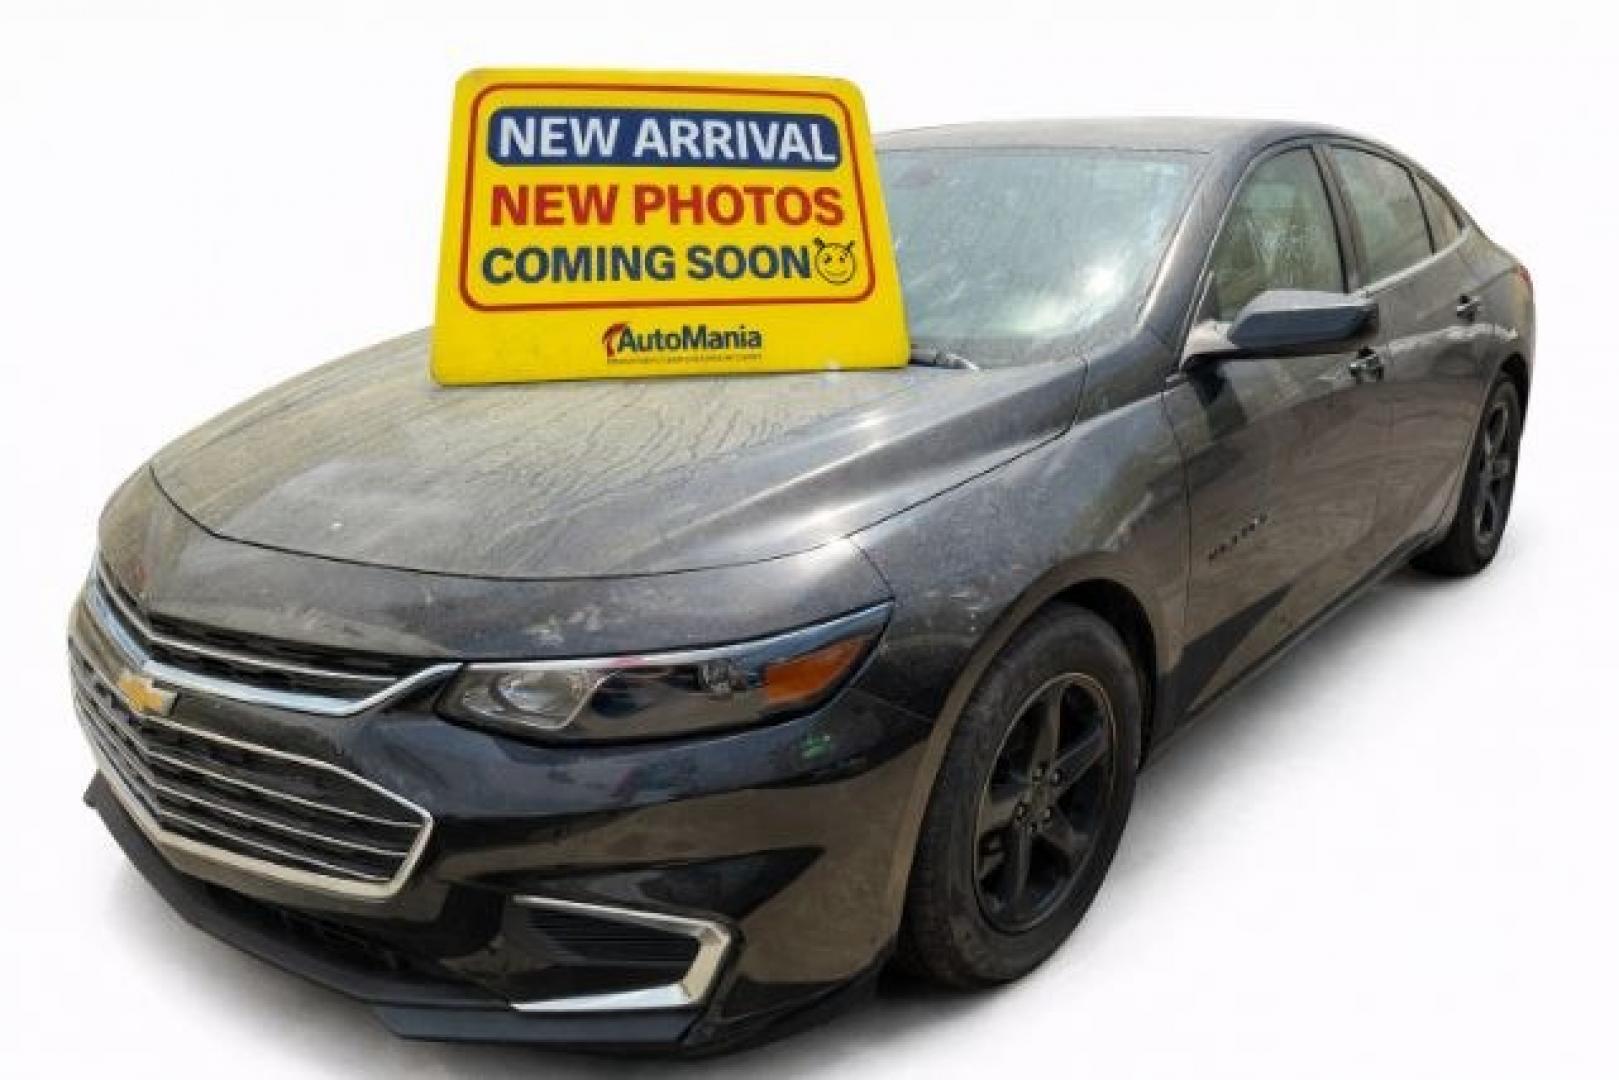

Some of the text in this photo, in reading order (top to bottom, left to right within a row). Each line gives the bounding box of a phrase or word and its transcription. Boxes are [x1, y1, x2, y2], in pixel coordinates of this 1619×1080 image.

[499, 115, 836, 164] NEW ARRIVAL
[489, 184, 845, 227] NEW PHOTOS
[481, 243, 812, 285] COMING SOON
[616, 323, 762, 352] AutoMania
